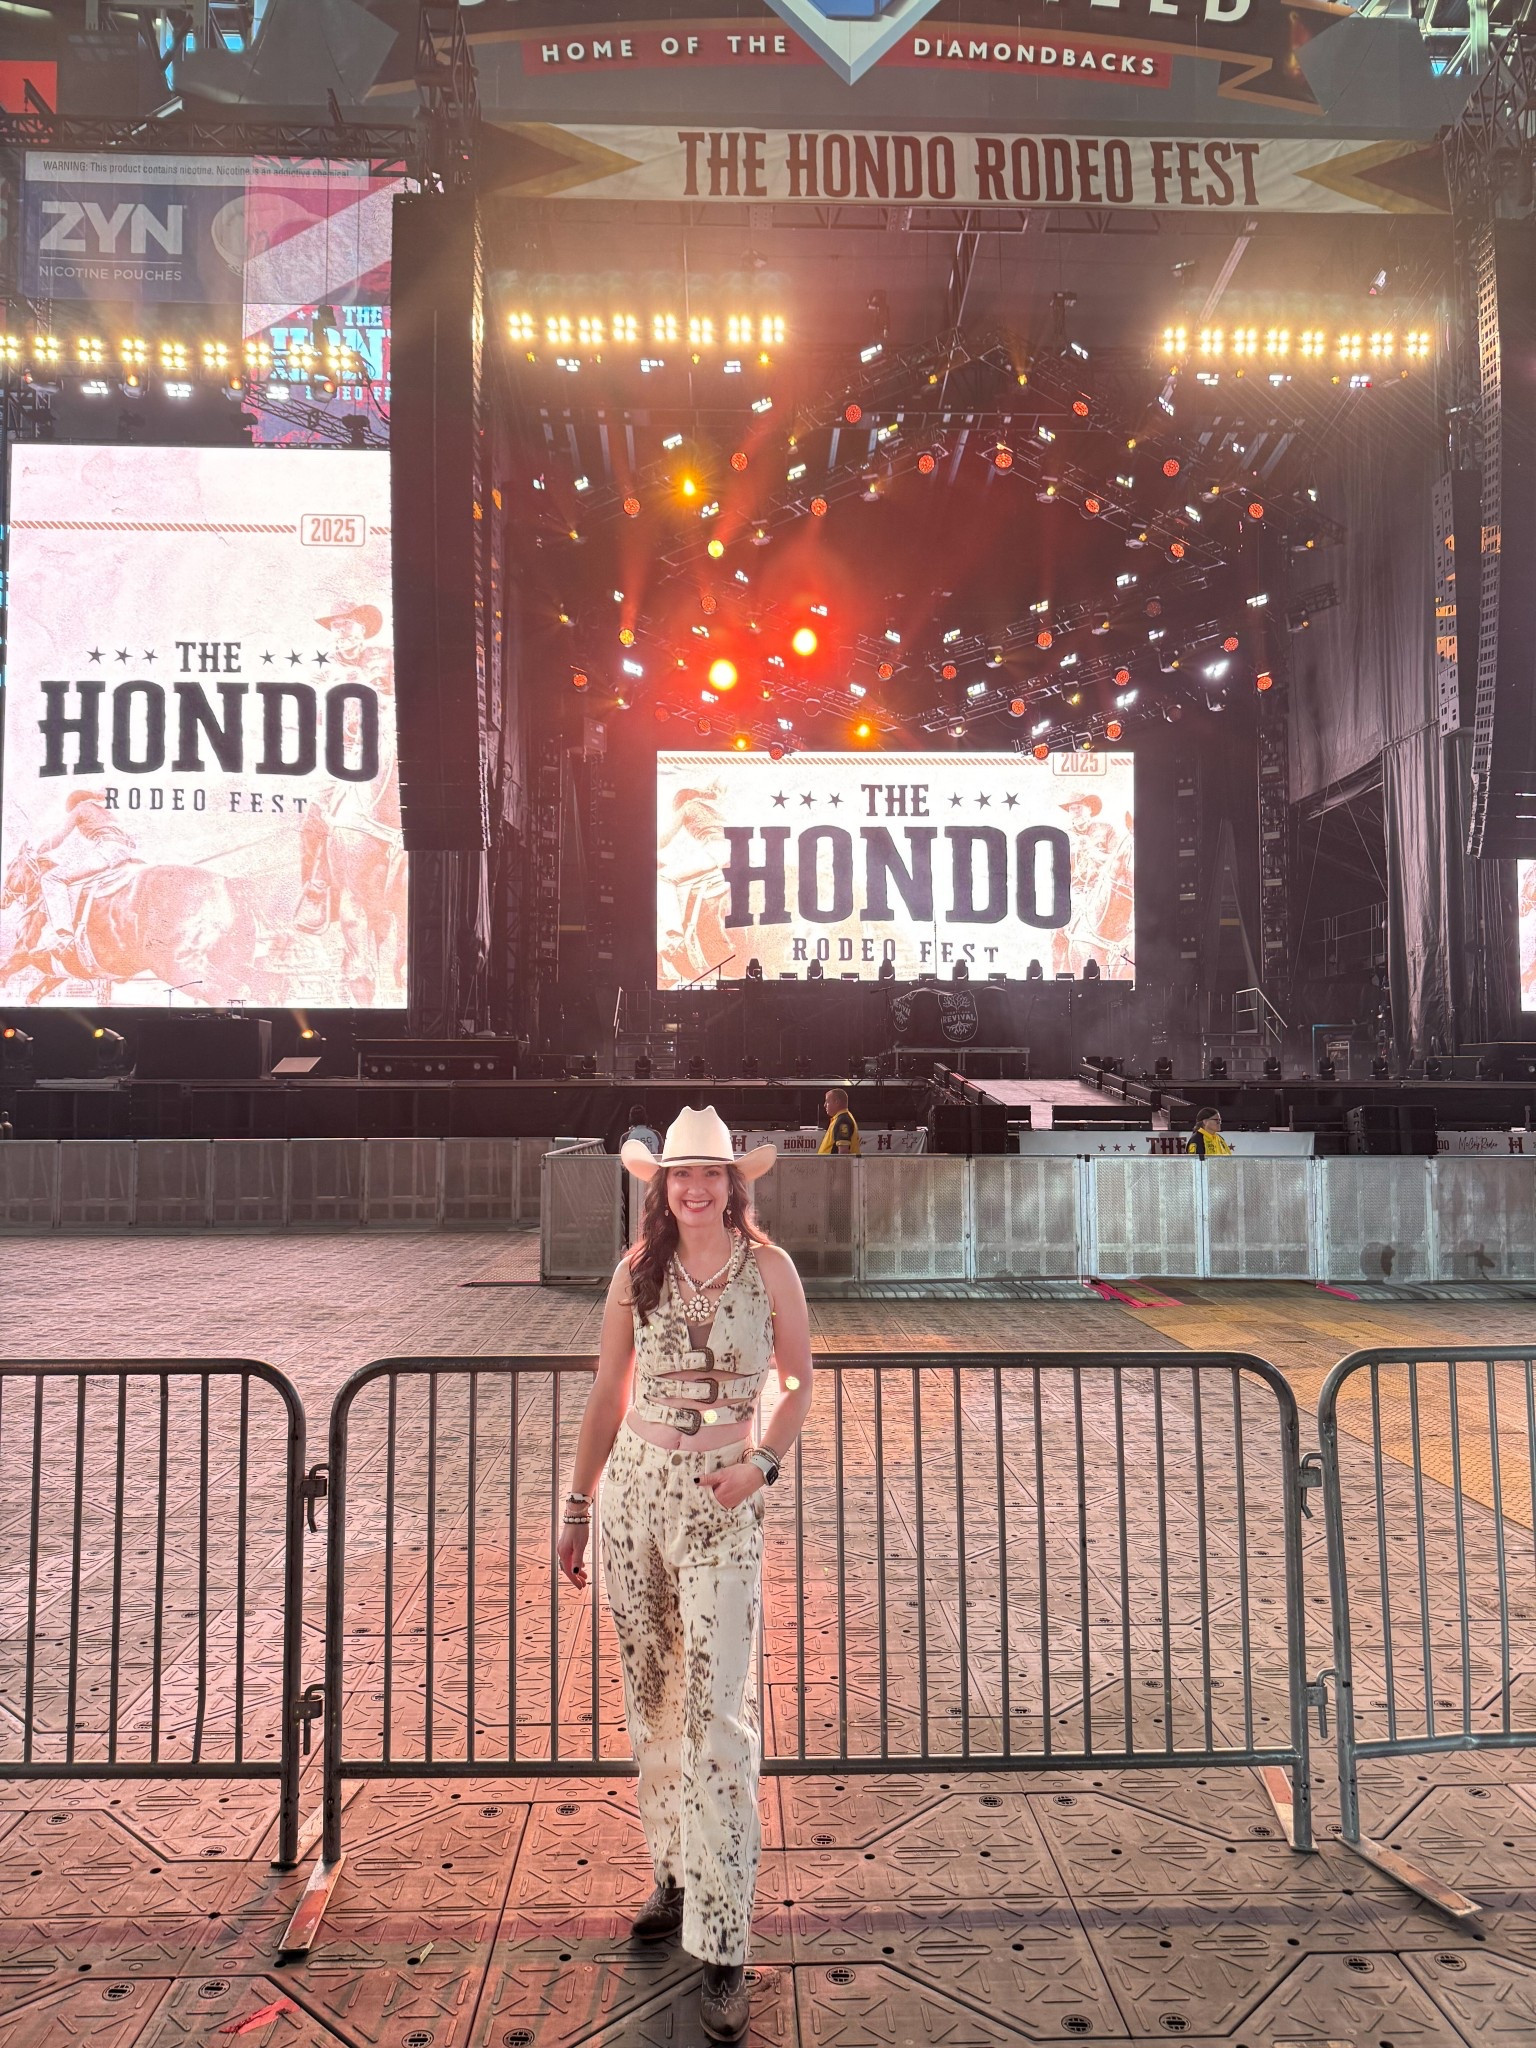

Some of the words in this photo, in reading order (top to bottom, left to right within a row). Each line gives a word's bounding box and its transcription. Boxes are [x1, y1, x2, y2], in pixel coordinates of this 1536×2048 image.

[542, 39, 633, 62] HOME
[661, 37, 698, 55] OF
[727, 35, 786, 53] THE
[914, 38, 1154, 75] DIAMONDBACKS
[43, 160, 88, 171] WARNING:
[91, 161, 107, 172] This
[109, 163, 141, 174] product
[143, 165, 177, 174] contains
[217, 165, 250, 176] Nicotine
[678, 132, 768, 196] THE
[786, 133, 956, 199] HONDO
[974, 137, 1134, 203] RODEO
[1150, 141, 1260, 206] FEST
[39, 201, 183, 254] ZYN
[39, 265, 109, 279] NICOTINE
[114, 269, 182, 281] POUCHES
[342, 305, 383, 326] THE
[311, 518, 356, 543] 2025
[175, 641, 242, 673] THE
[37, 680, 380, 782] HONDO
[1061, 751, 1099, 773] 2025
[104, 788, 206, 811] RODEO
[229, 791, 309, 814] FEST
[861, 783, 930, 817] THE
[722, 825, 1072, 929] HONDO
[793, 937, 897, 962] RODEO
[920, 940, 1000, 964] FEST
[942, 1013, 976, 1024] REVIVAL
[784, 1139, 817, 1149] HONDO
